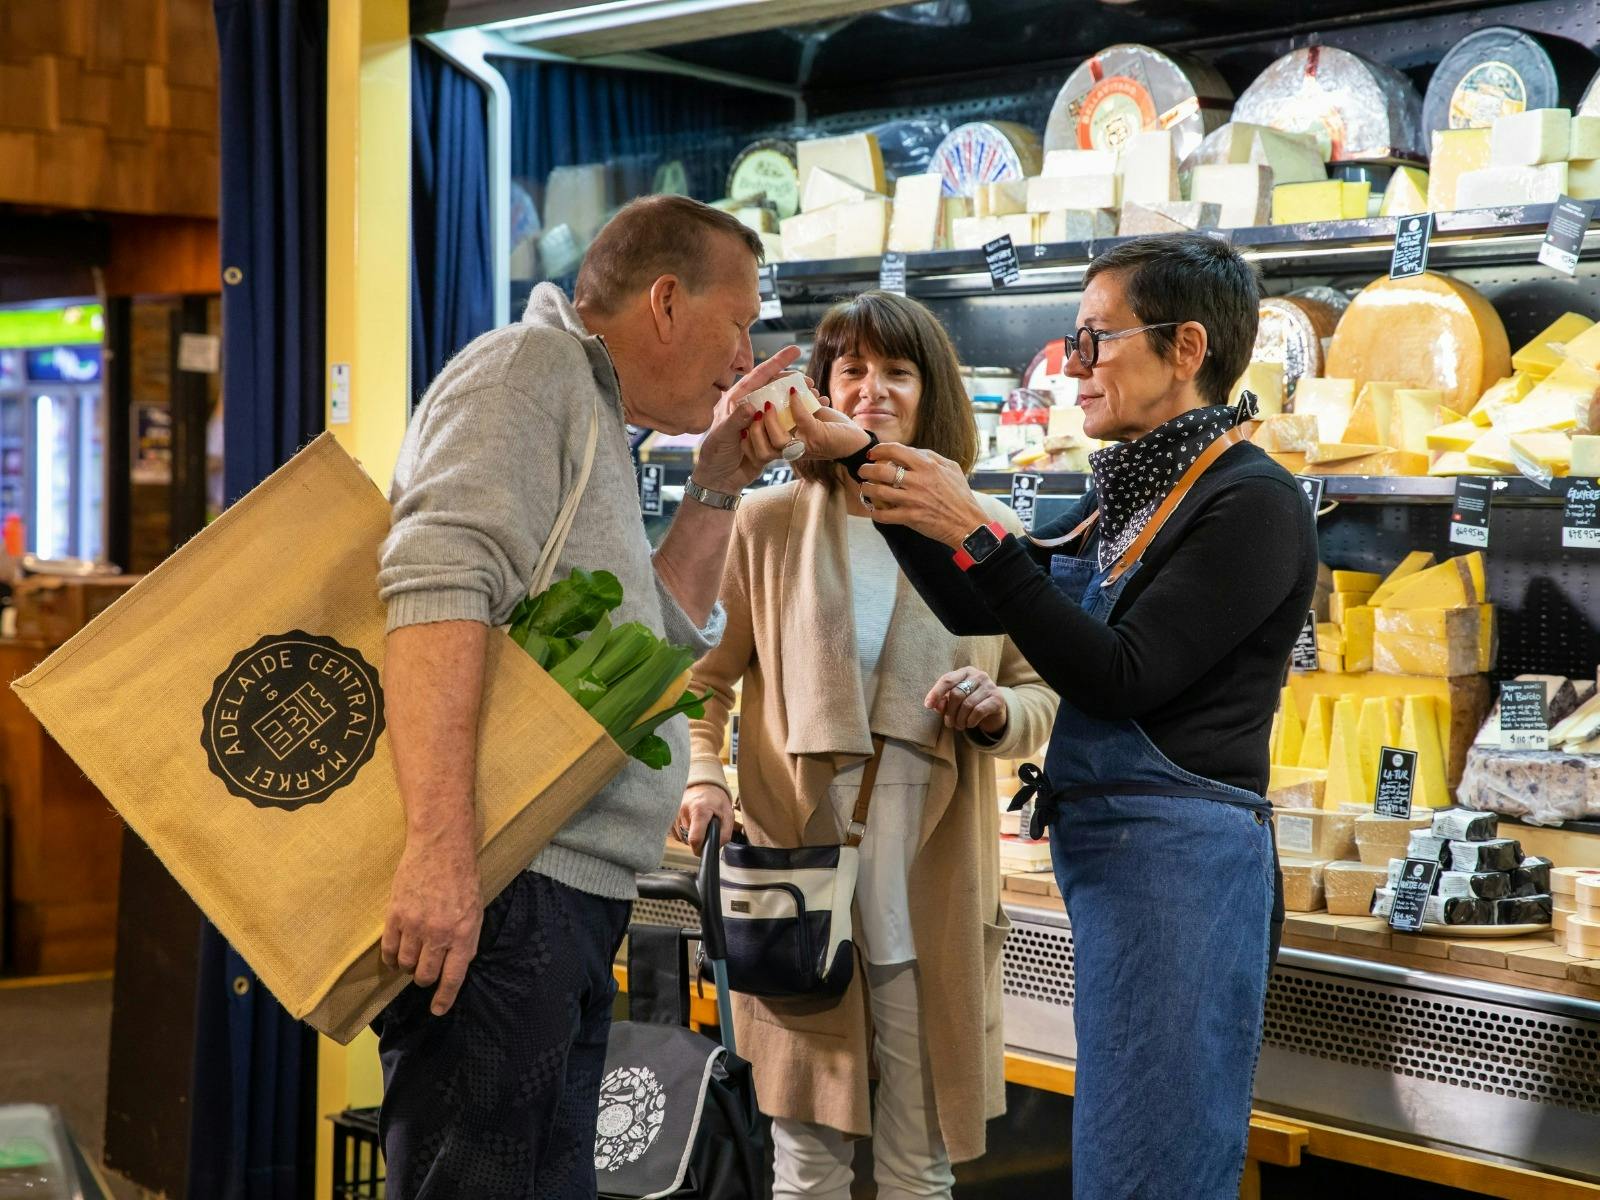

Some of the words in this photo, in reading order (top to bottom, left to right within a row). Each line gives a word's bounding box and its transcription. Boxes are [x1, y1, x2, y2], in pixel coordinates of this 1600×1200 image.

[220, 650, 293, 755] ADELAIDE
[260, 683, 279, 701] 18
[309, 653, 367, 740] CENTRAL
[245, 750, 347, 792] MARKET
